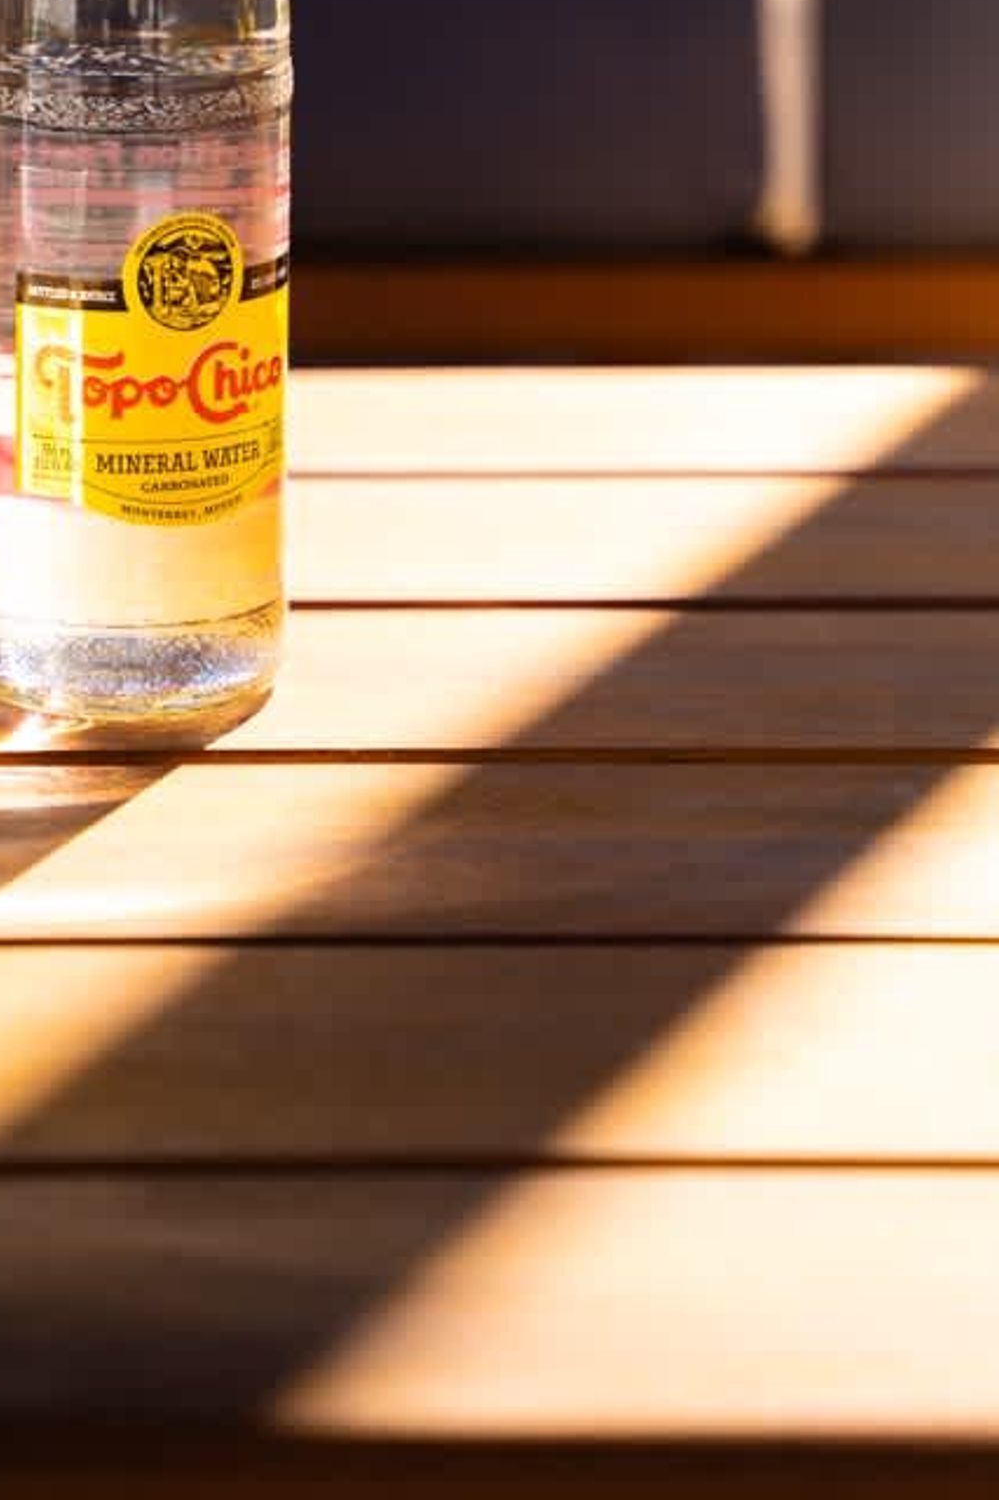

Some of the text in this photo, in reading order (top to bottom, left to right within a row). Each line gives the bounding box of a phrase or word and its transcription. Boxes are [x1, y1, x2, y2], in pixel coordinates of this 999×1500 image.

[34, 341, 283, 425] Topo Chico
[95, 450, 199, 475] MINERAL
[202, 439, 261, 470] WATER
[140, 473, 230, 494] CARBONATED
